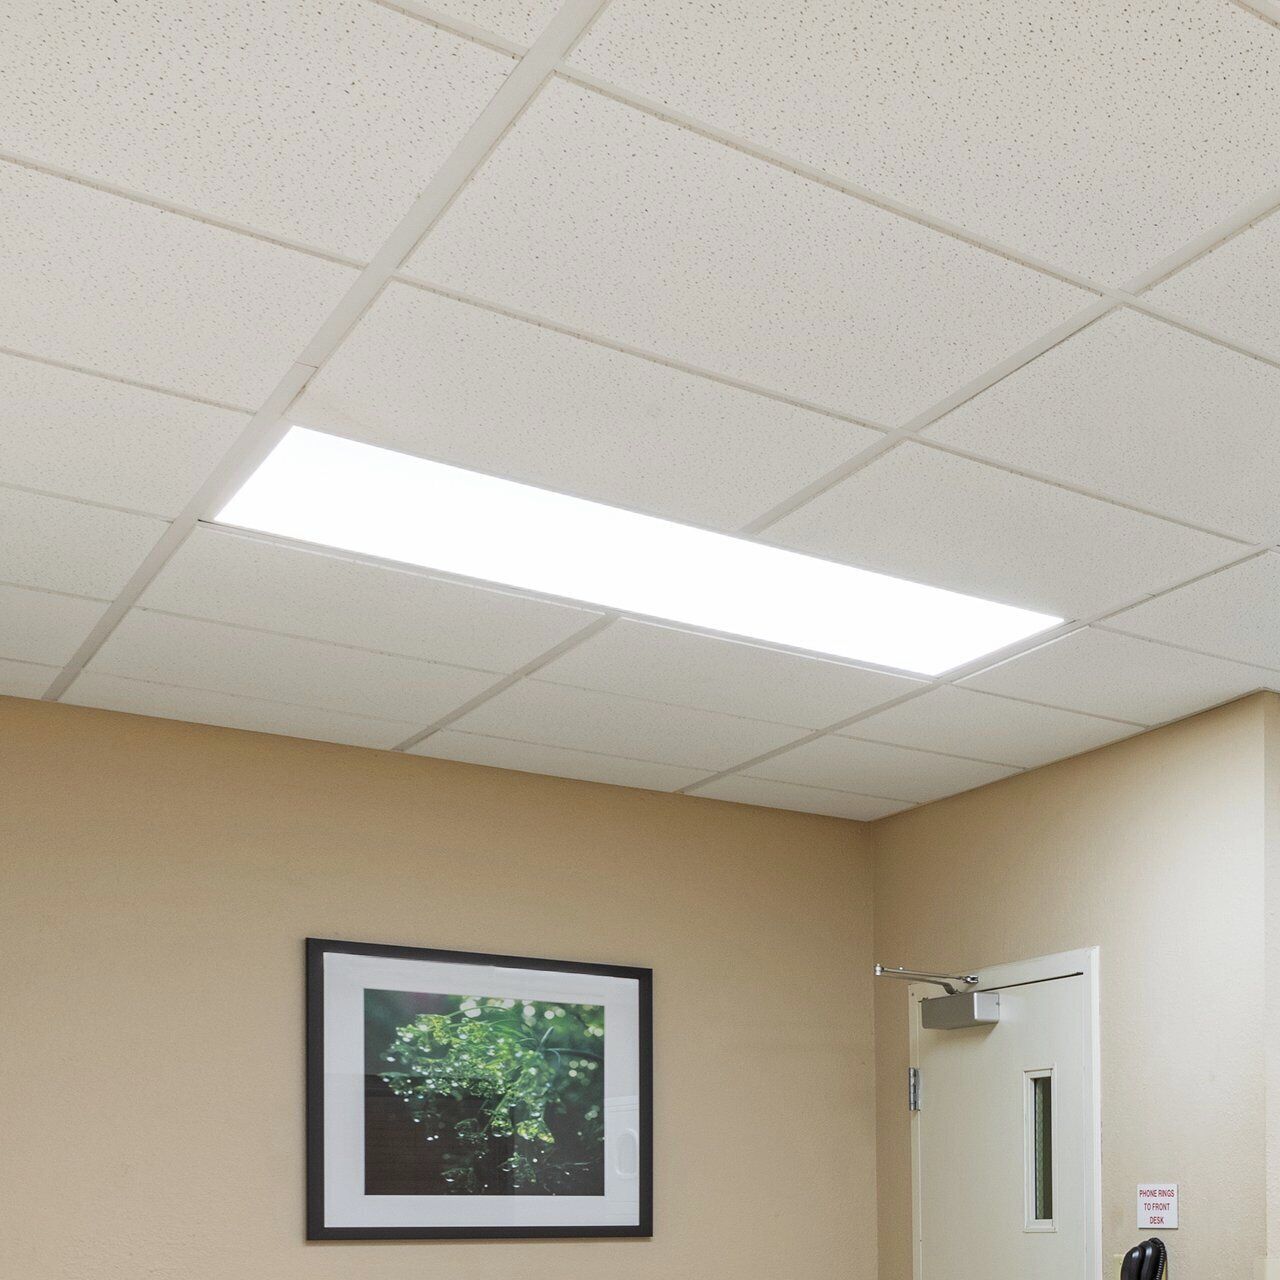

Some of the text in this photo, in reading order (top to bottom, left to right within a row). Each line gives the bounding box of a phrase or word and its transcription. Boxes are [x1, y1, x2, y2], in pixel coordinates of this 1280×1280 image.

[1139, 1189, 1175, 1198] PHONE RINGS
[1144, 1202, 1170, 1211] TO FRONT
[1150, 1216, 1165, 1225] DESK
